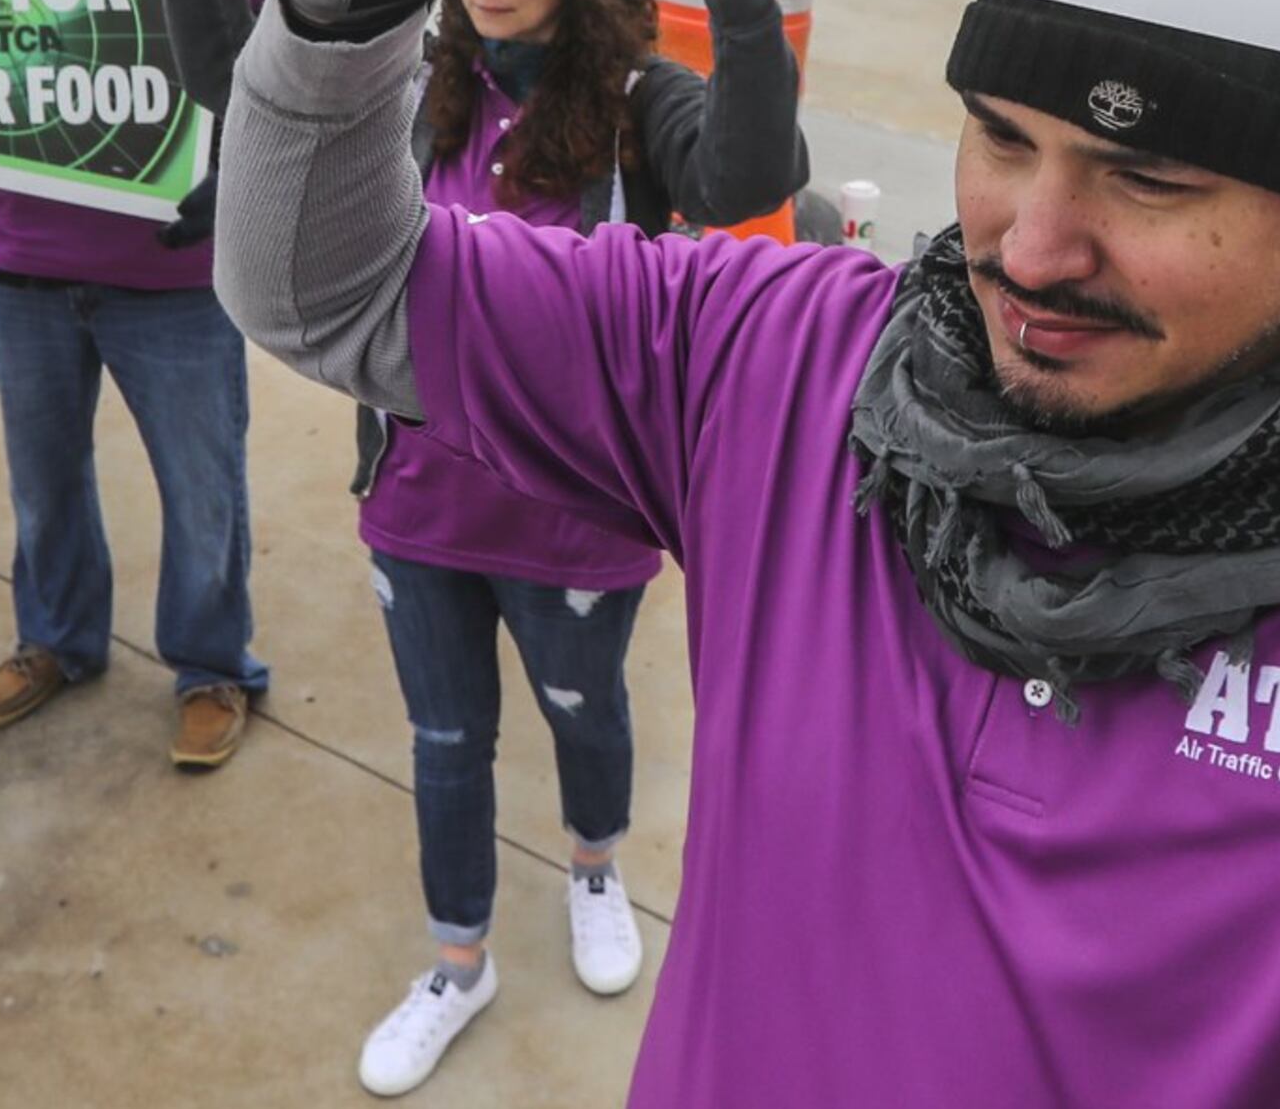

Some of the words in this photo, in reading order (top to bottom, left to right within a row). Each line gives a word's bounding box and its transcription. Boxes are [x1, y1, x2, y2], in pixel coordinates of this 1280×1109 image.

[25, 65, 170, 125] FOOD
[1175, 735, 1204, 761] Air
[1208, 743, 1273, 779] Traffic
